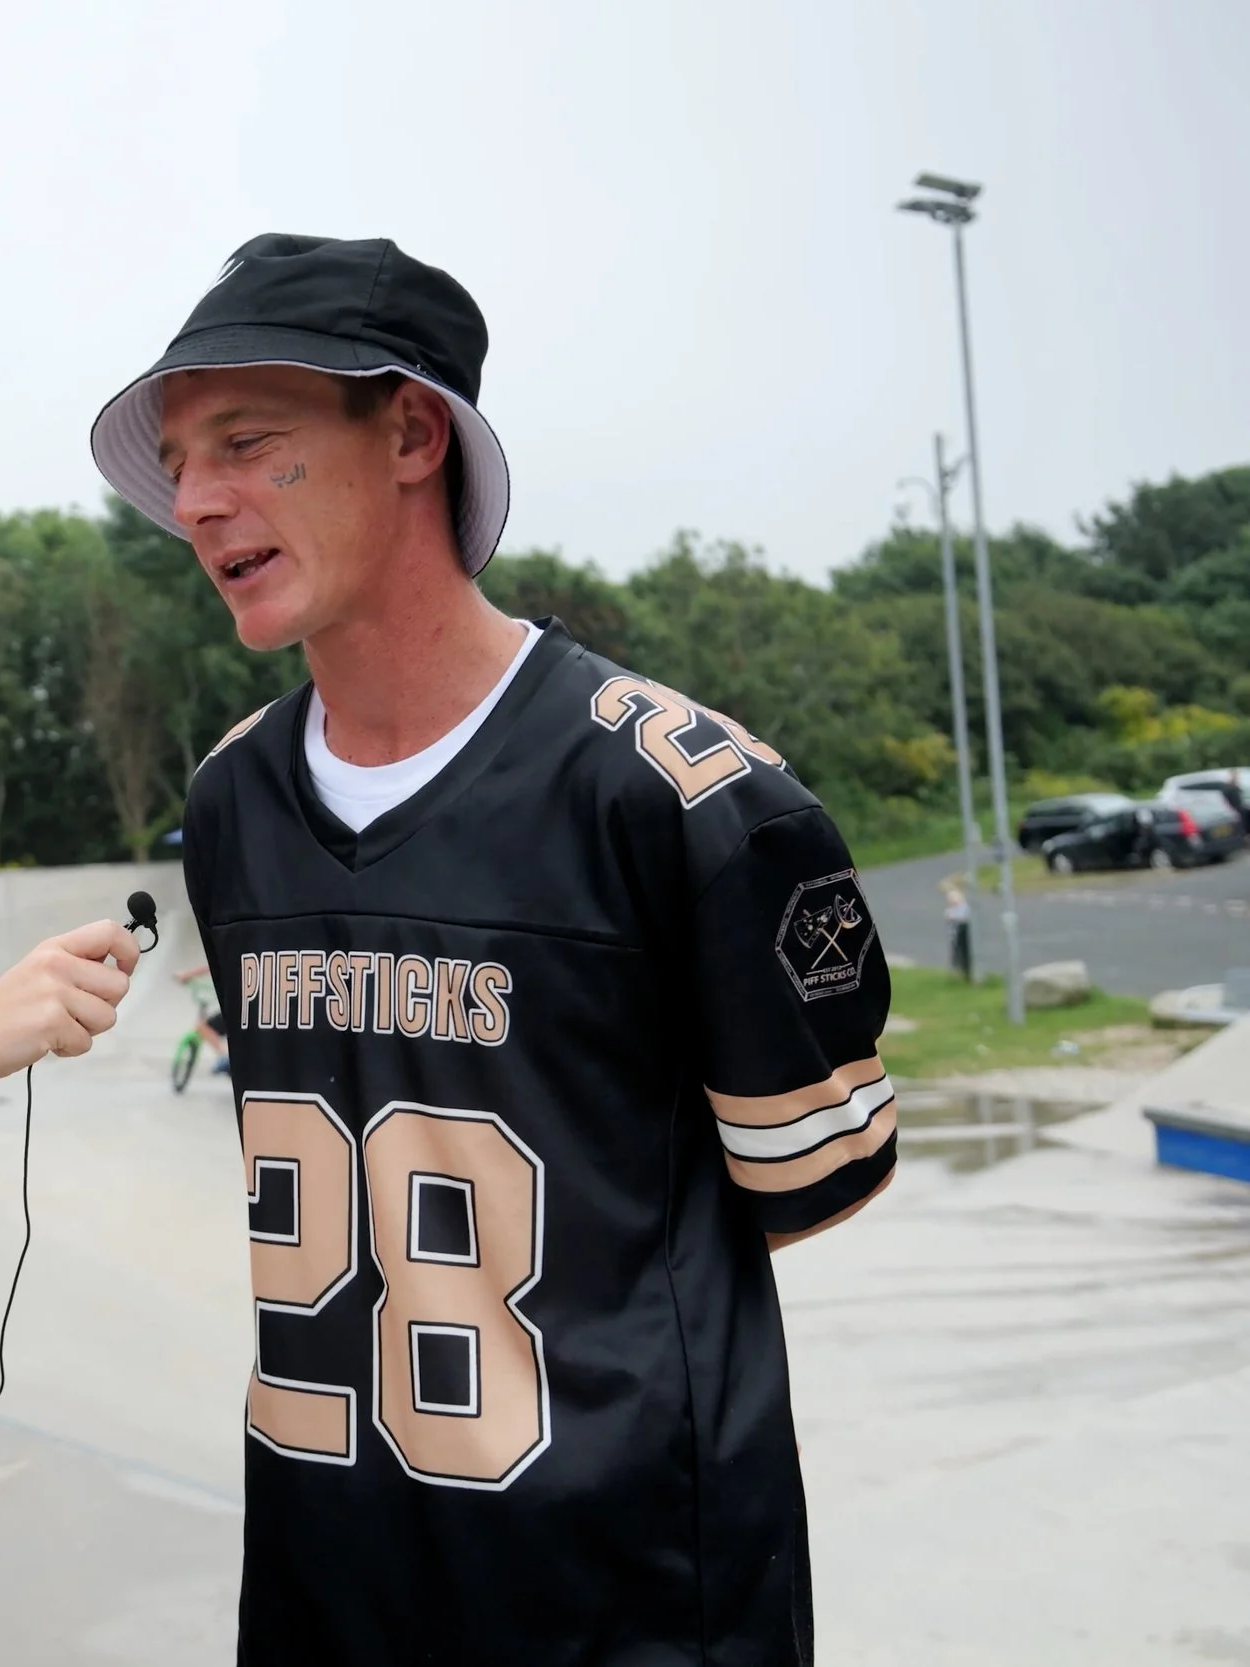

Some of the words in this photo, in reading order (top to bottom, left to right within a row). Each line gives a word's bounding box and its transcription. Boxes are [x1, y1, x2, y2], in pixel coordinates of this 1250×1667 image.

[241, 950, 513, 1047] PIFFSTICKS
[803, 975, 820, 987] PIFF
[820, 969, 847, 983] STICKS
[242, 1090, 552, 1492] 28
